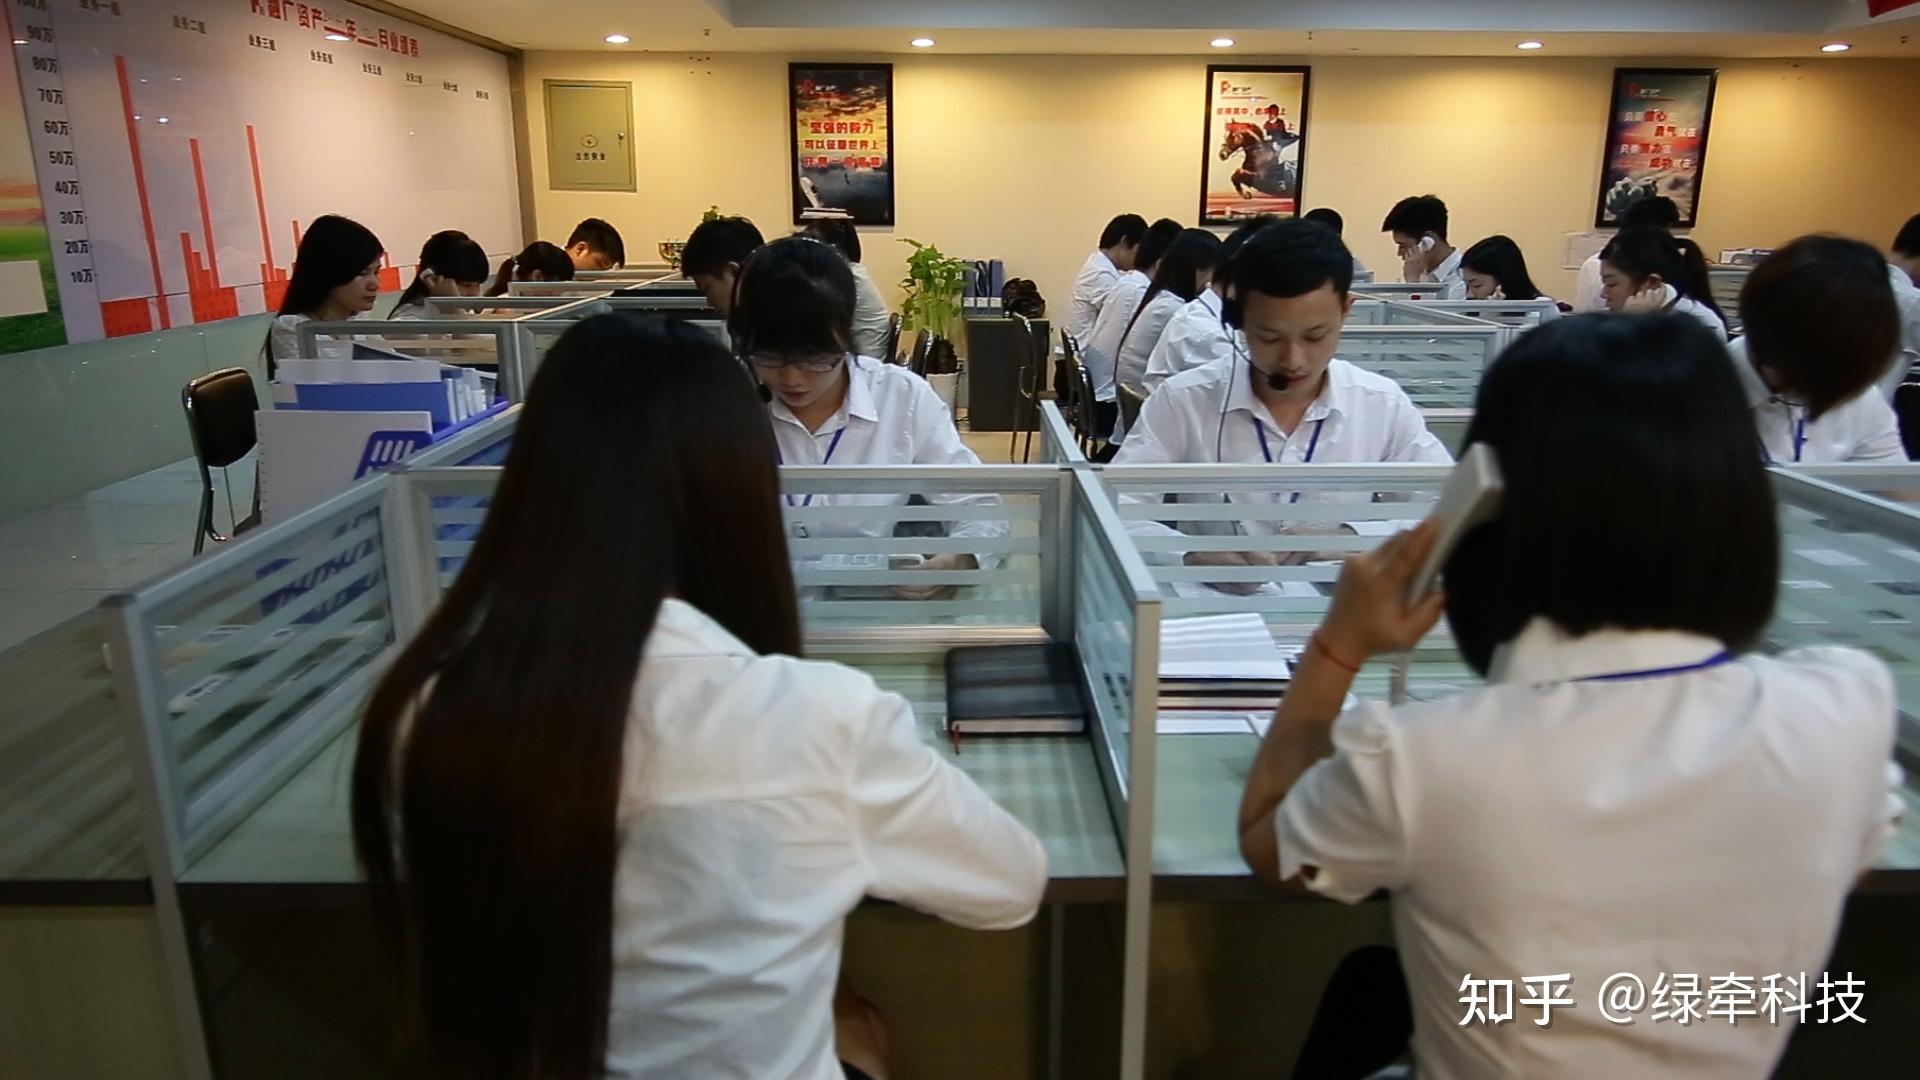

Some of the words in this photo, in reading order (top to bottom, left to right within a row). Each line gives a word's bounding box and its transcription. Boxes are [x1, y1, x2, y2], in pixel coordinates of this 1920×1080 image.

[27, 25, 53, 43] 90万
[32, 56, 58, 73] 80万
[37, 88, 63, 104] 70万
[44, 121, 68, 135] 60万
[49, 151, 74, 166] 50万
[55, 181, 79, 195] 40万
[60, 210, 84, 225] 30万
[65, 240, 88, 254] 20万
[71, 268, 93, 283] 10万
